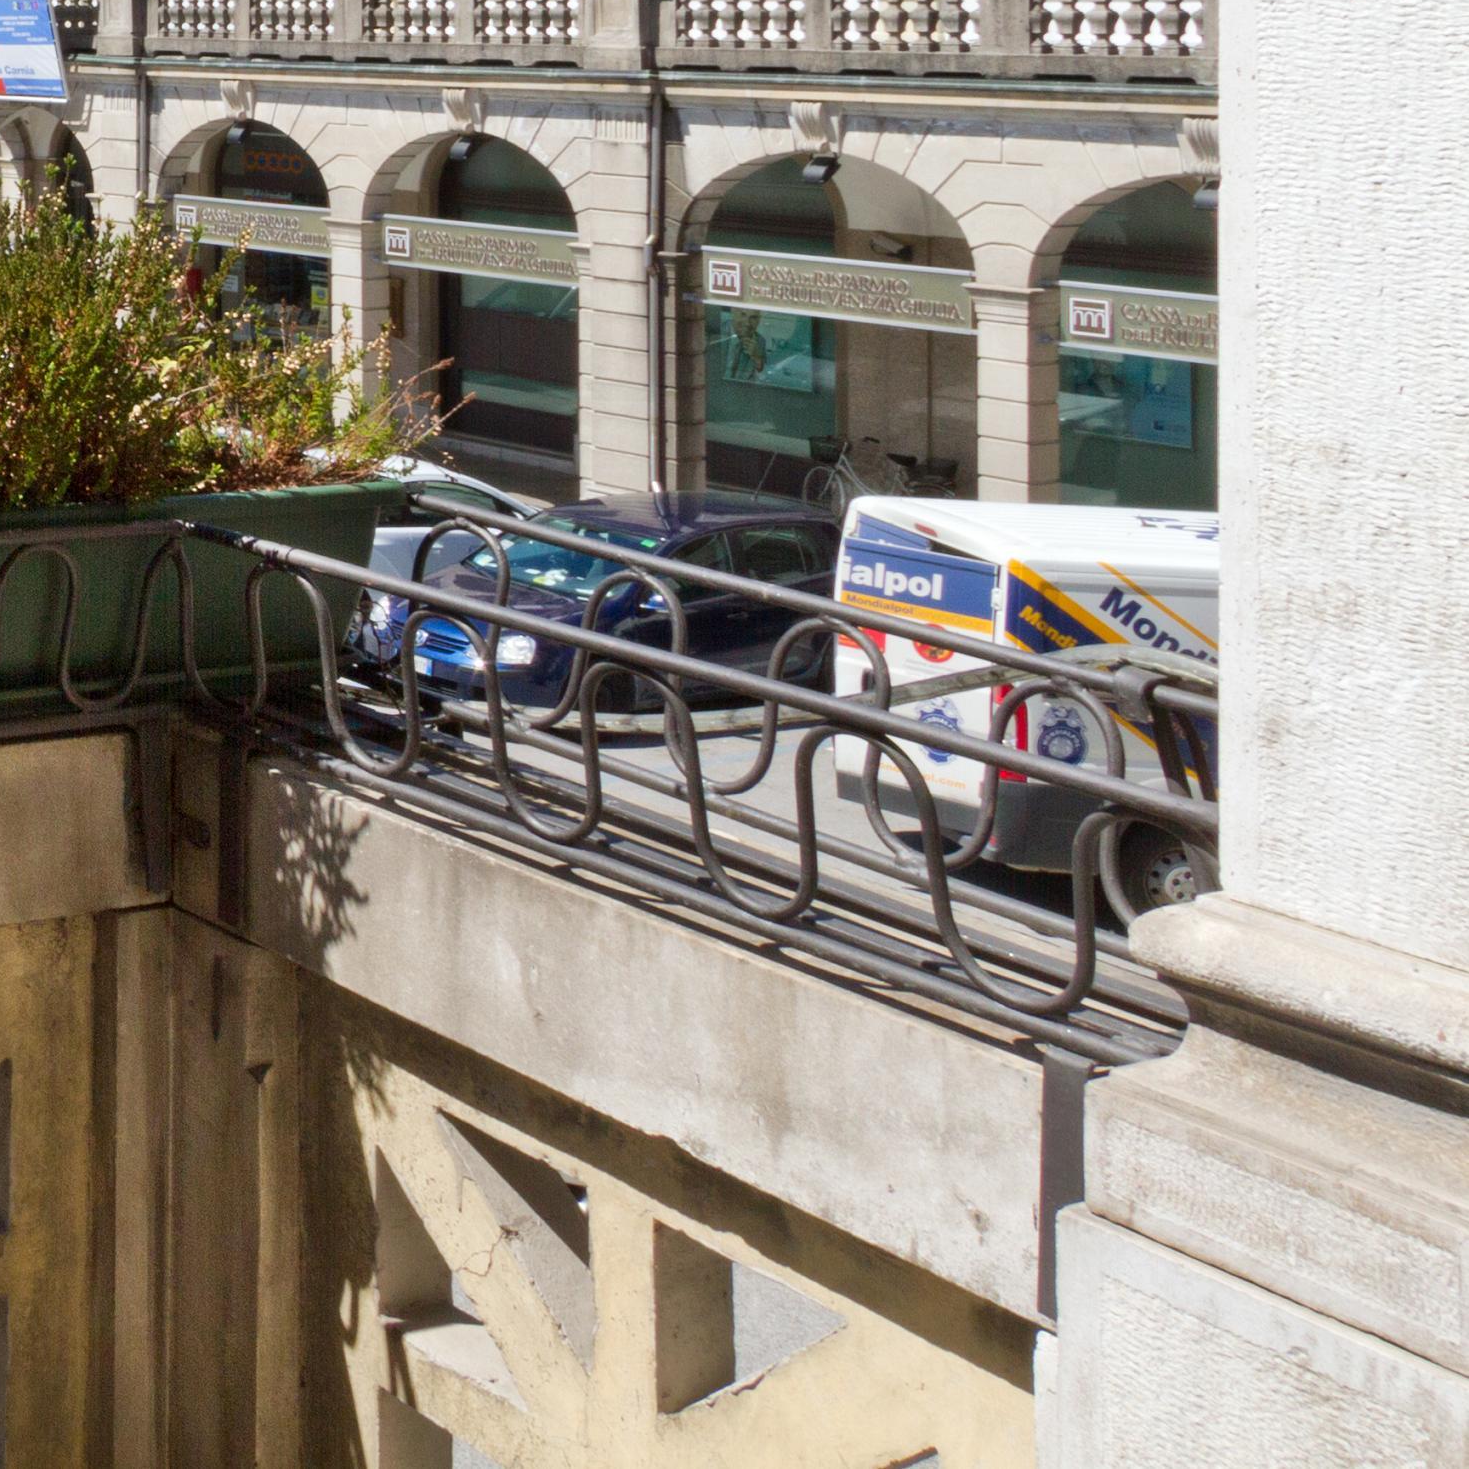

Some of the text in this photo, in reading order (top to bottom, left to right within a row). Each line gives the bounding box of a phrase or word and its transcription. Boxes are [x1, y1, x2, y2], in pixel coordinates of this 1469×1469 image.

[4, 65, 36, 75] Carnia
[201, 206, 231, 223] CASSA
[243, 211, 300, 229] RISPARMIO
[415, 229, 454, 245] CASSA
[464, 235, 538, 254] RISPARMIO
[433, 246, 477, 263] FRIULI
[478, 250, 527, 270] VENEZIA
[528, 258, 577, 277] GIULIA
[749, 264, 911, 296] CASSA DI RISPARMIO
[772, 284, 825, 305] FRIULI
[827, 289, 896, 313] VENEZIA
[899, 298, 966, 322] GIULIA
[1120, 302, 1183, 326] CASSA
[1186, 313, 1204, 328] DI
[1120, 327, 1151, 342] DEL
[842, 555, 944, 601] ialpol
[846, 593, 915, 615] Mondialpol
